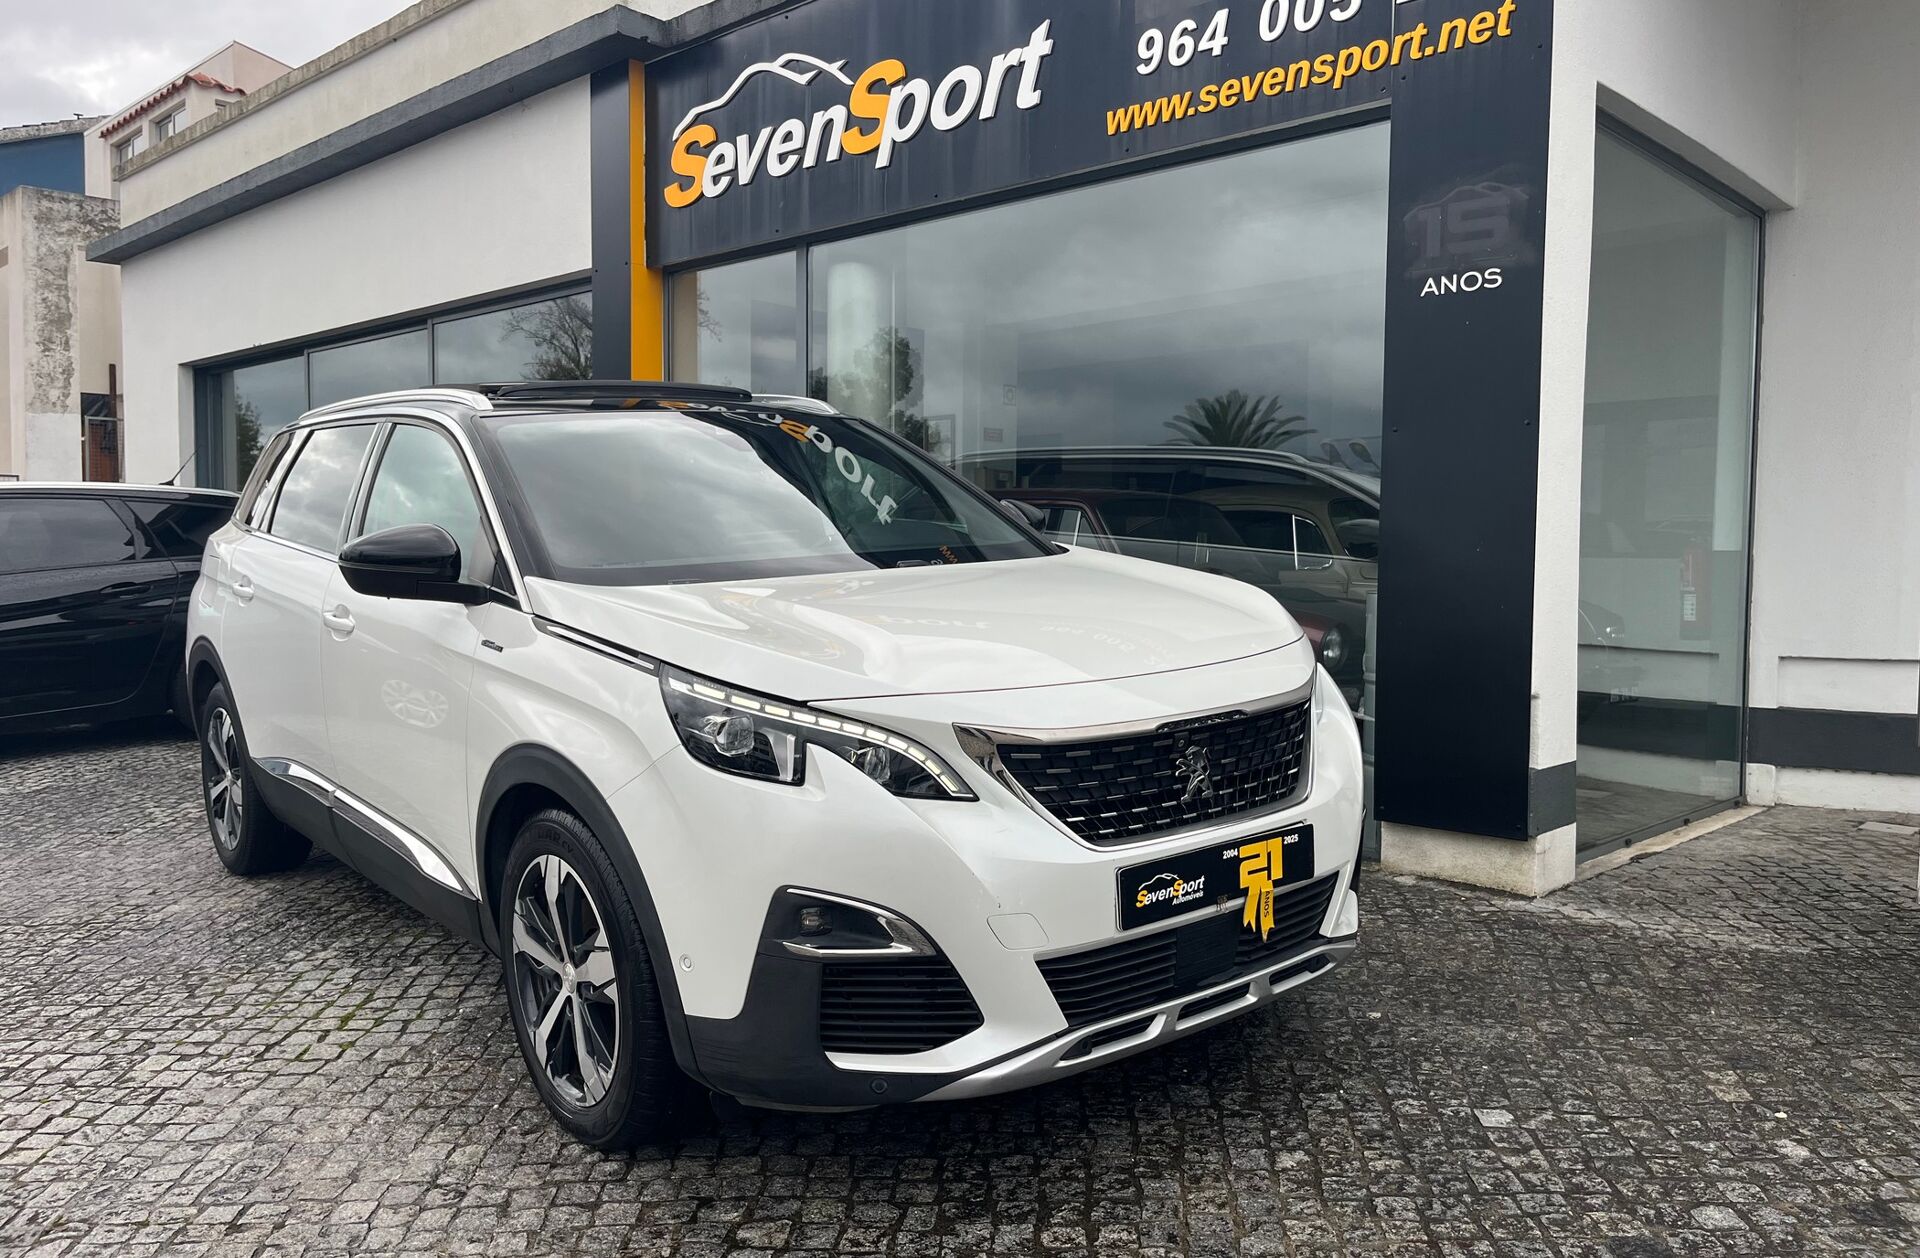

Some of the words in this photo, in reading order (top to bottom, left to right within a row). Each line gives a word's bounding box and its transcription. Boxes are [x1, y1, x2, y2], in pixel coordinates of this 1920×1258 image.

[1136, 9, 1229, 75] 964
[1106, 0, 1516, 136] www.sevensport.net
[664, 19, 1054, 208] SevenSport
[1420, 268, 1503, 297] ANOS
[1223, 850, 1239, 859] 2004
[1284, 834, 1299, 843] 2025
[1239, 837, 1283, 889] 21
[1135, 875, 1205, 908] SevenSport
